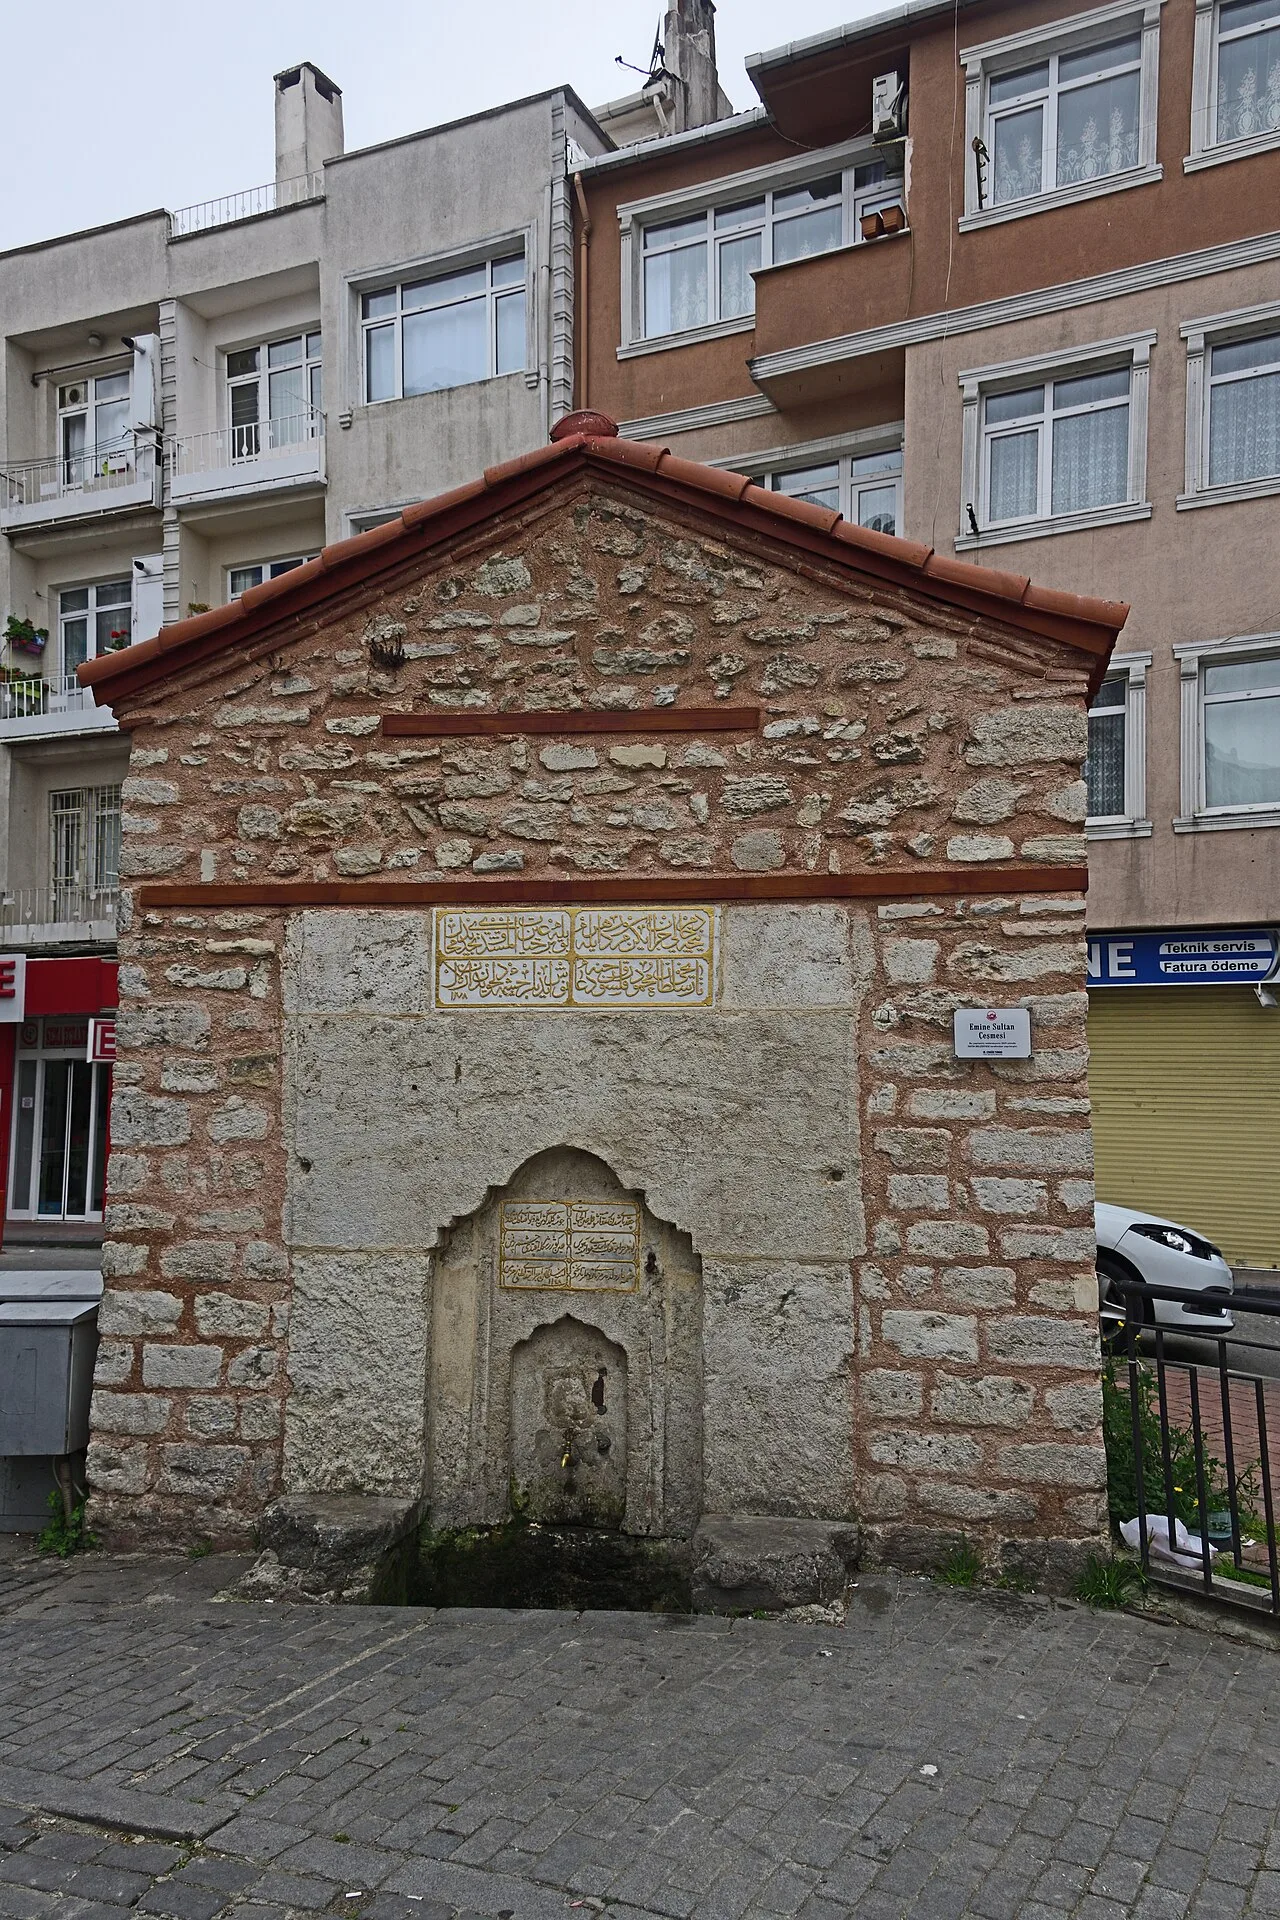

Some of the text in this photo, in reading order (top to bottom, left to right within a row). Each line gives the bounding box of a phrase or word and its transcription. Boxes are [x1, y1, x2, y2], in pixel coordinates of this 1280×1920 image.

[1165, 940, 1256, 954] Teknik servis
[1164, 961, 1259, 973] Fatura ödeme
[969, 1023, 1015, 1031] Emine Sultan
